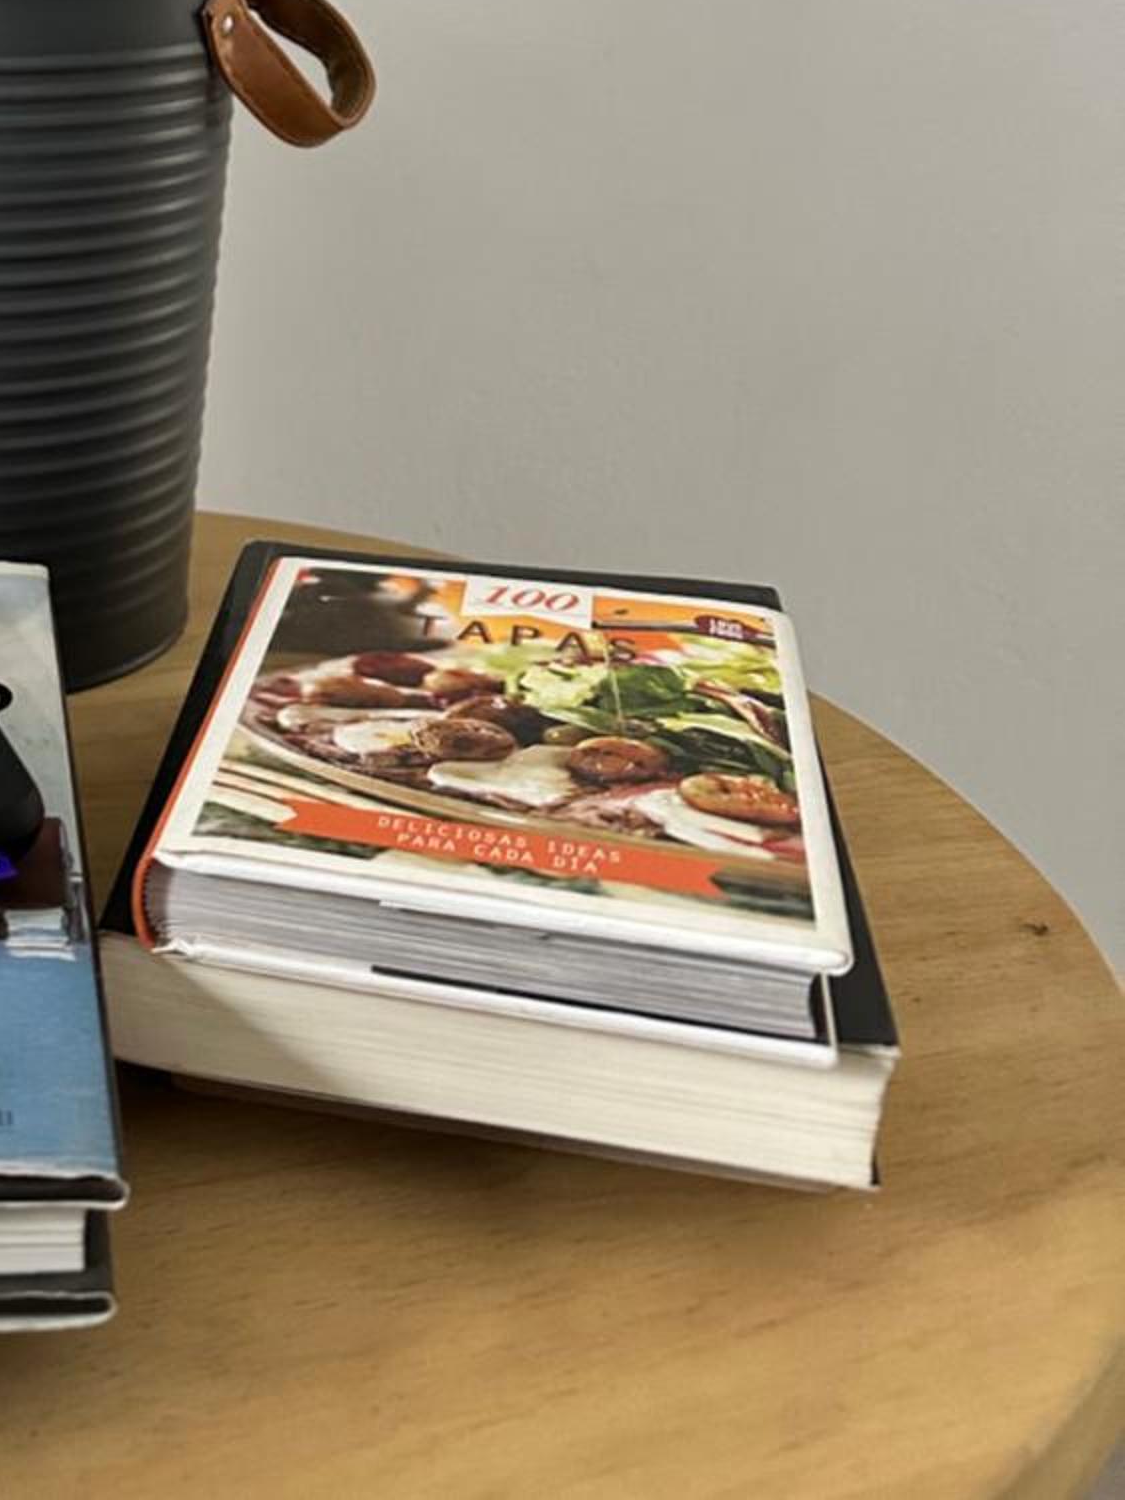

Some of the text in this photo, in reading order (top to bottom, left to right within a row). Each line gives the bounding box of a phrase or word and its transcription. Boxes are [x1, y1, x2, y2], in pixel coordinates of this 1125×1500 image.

[481, 584, 581, 613] 100
[421, 615, 639, 663] TAPAS
[378, 816, 622, 864] DELICIOSAS IDEAS
[397, 832, 456, 852] PARA
[474, 845, 535, 864] CADA
